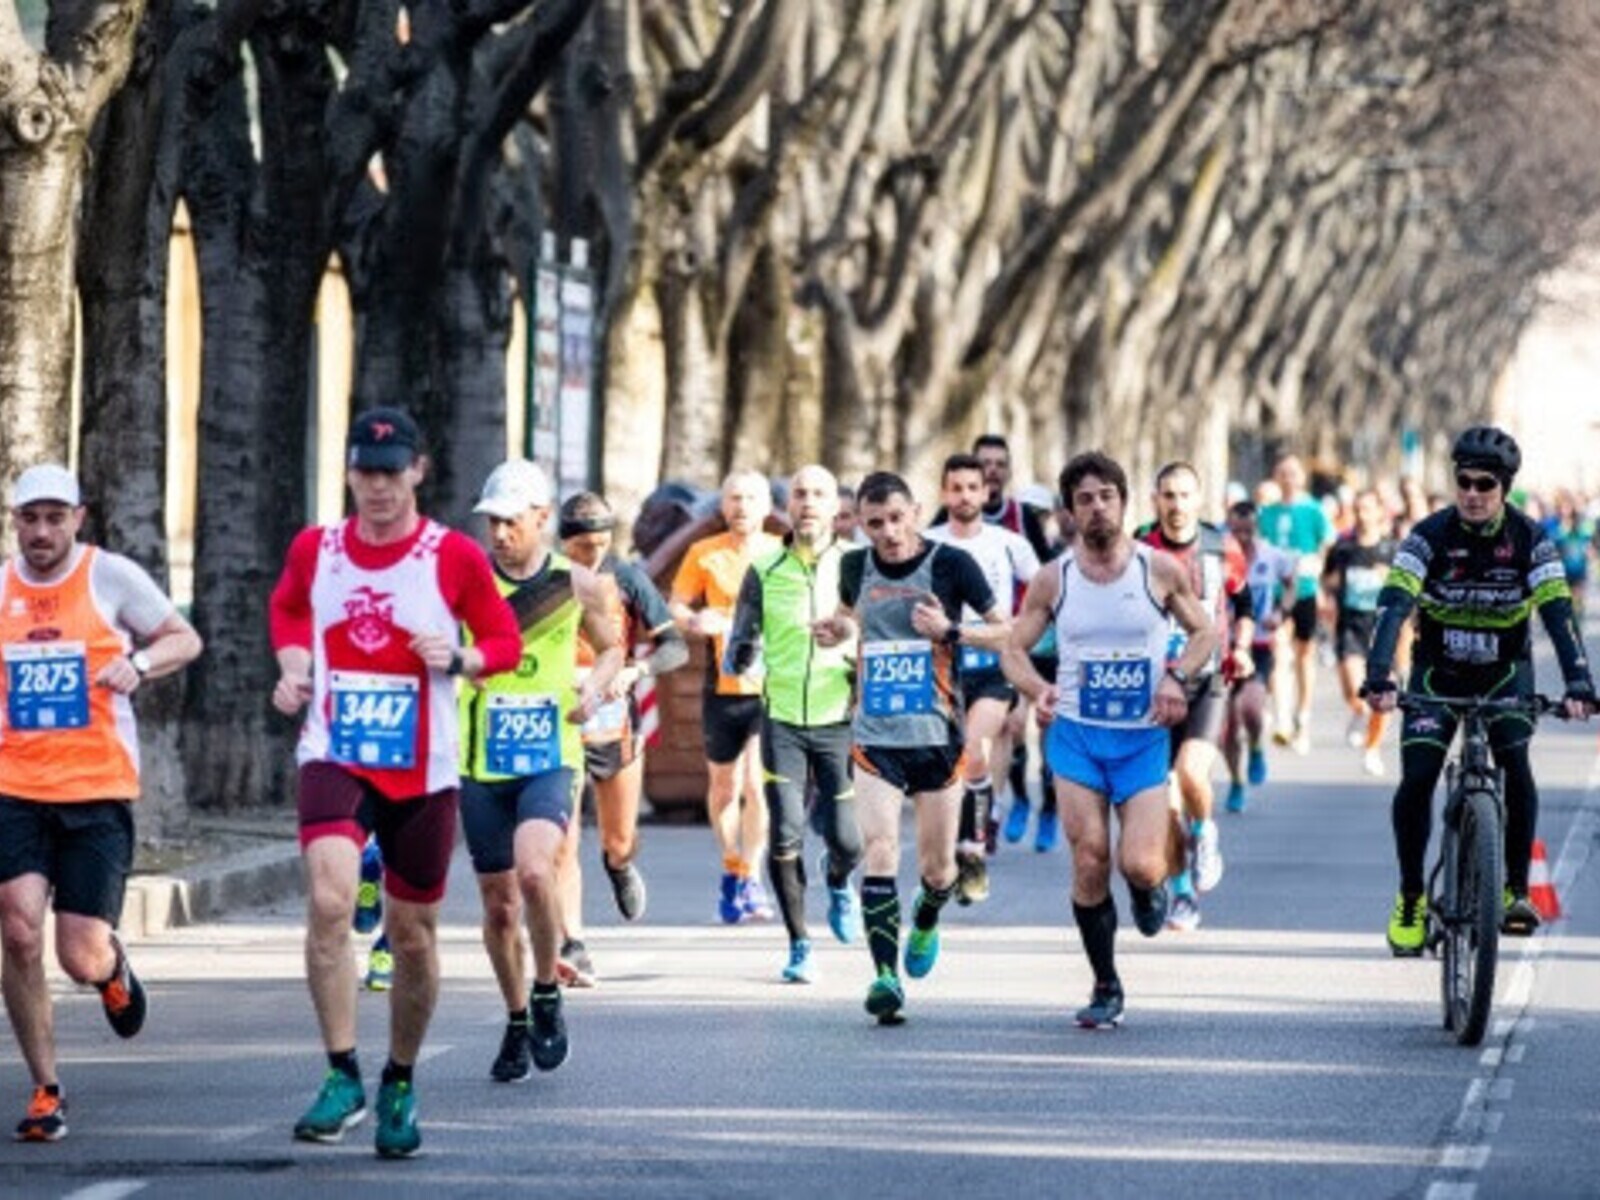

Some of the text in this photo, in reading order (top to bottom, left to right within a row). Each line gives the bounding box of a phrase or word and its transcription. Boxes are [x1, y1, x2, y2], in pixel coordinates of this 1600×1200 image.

[17, 661, 79, 693] 2875
[873, 656, 925, 682] 2504
[1088, 664, 1145, 690] 3666
[340, 694, 412, 729] 3447
[496, 711, 551, 740] 2956
